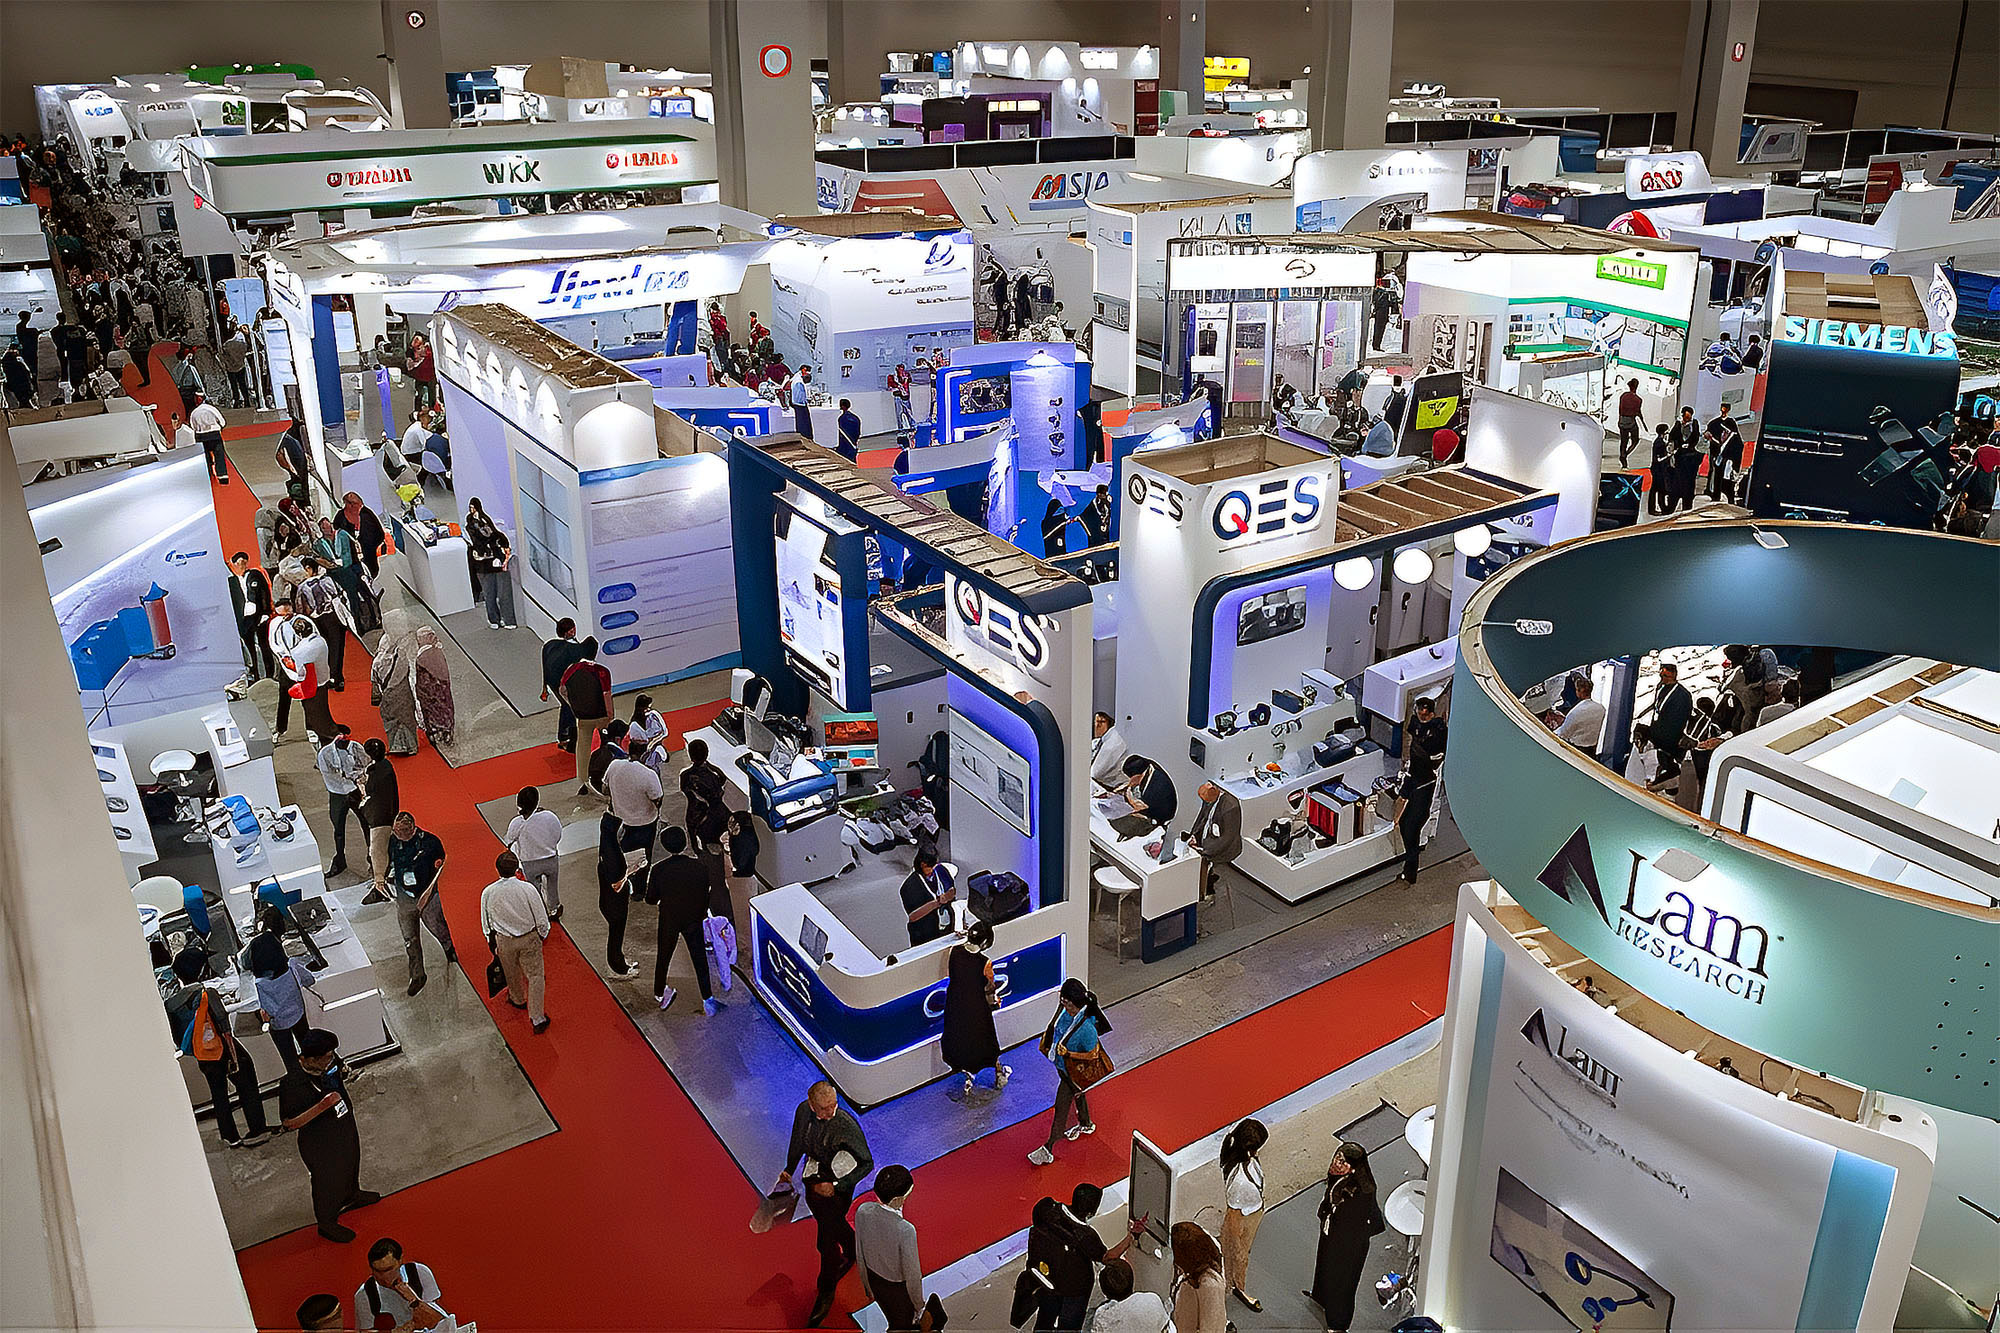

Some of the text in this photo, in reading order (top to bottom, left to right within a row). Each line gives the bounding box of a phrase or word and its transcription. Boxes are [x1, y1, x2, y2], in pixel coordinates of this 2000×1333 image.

[1785, 315, 1958, 360] SIEMENS
[1128, 473, 1184, 522] QES
[1212, 475, 1320, 541] QES
[1619, 847, 1769, 980] Lam
[1616, 916, 1766, 1005] RESEARCH
[1556, 1024, 1624, 1098] Lam
